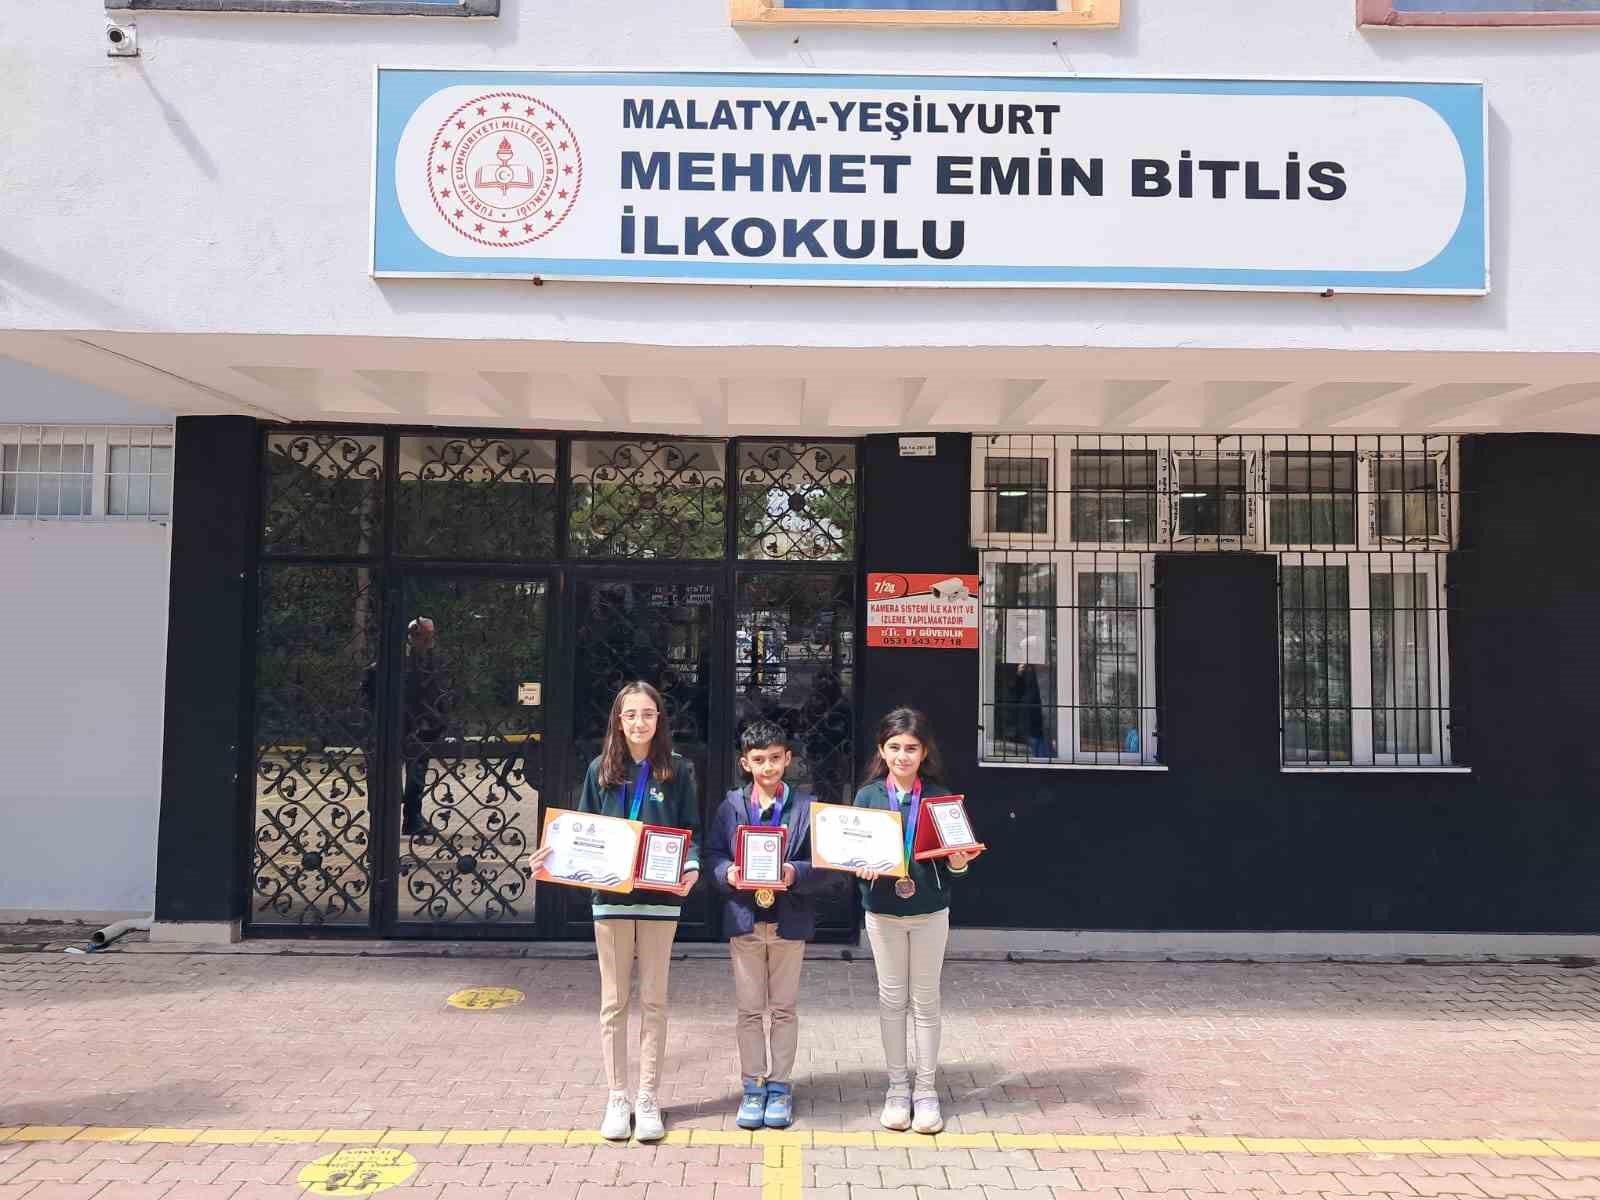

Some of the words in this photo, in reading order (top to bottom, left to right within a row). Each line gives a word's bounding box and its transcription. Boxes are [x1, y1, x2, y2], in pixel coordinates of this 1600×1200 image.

[623, 95, 1061, 141] MALATYA-YEŞİLYURT
[456, 120, 499, 180] CUMHURİYETİ
[531, 130, 554, 166] EĞİTİM
[516, 167, 554, 217] BAKANLIĞI
[621, 151, 912, 194] MEHMET
[936, 147, 1104, 197] EMİN
[1131, 150, 1347, 201] BİTLİS
[458, 182, 493, 217] TÜRKİYE
[620, 205, 965, 260] İLKOKULU
[871, 603, 899, 614] KAMERA
[964, 604, 974, 615] VE
[908, 615, 964, 625] YAPILMAKTADIR
[933, 638, 946, 646] 77
